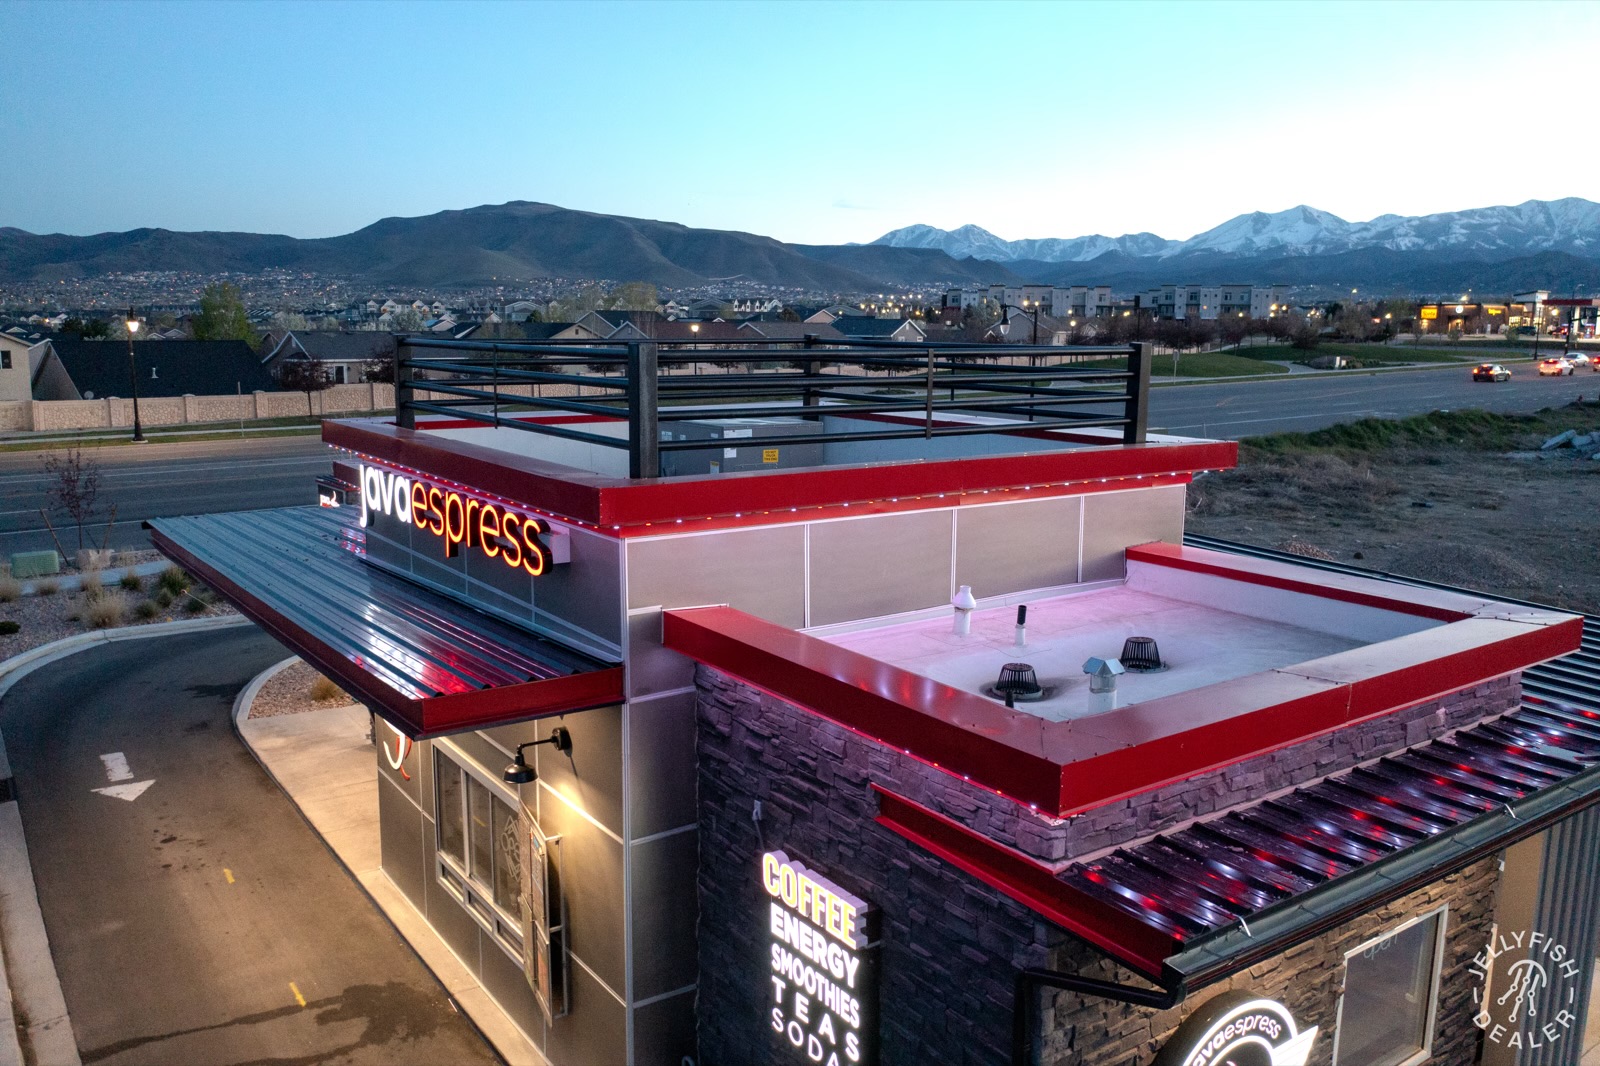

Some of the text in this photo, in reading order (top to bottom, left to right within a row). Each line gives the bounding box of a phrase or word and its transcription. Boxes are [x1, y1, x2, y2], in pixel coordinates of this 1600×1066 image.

[763, 852, 857, 950] COFFEE
[771, 902, 859, 988] ENERGY
[771, 943, 860, 1028] SMOOTHIES
[771, 975, 860, 1062] TEAS
[1192, 1014, 1282, 1066] avaespress
